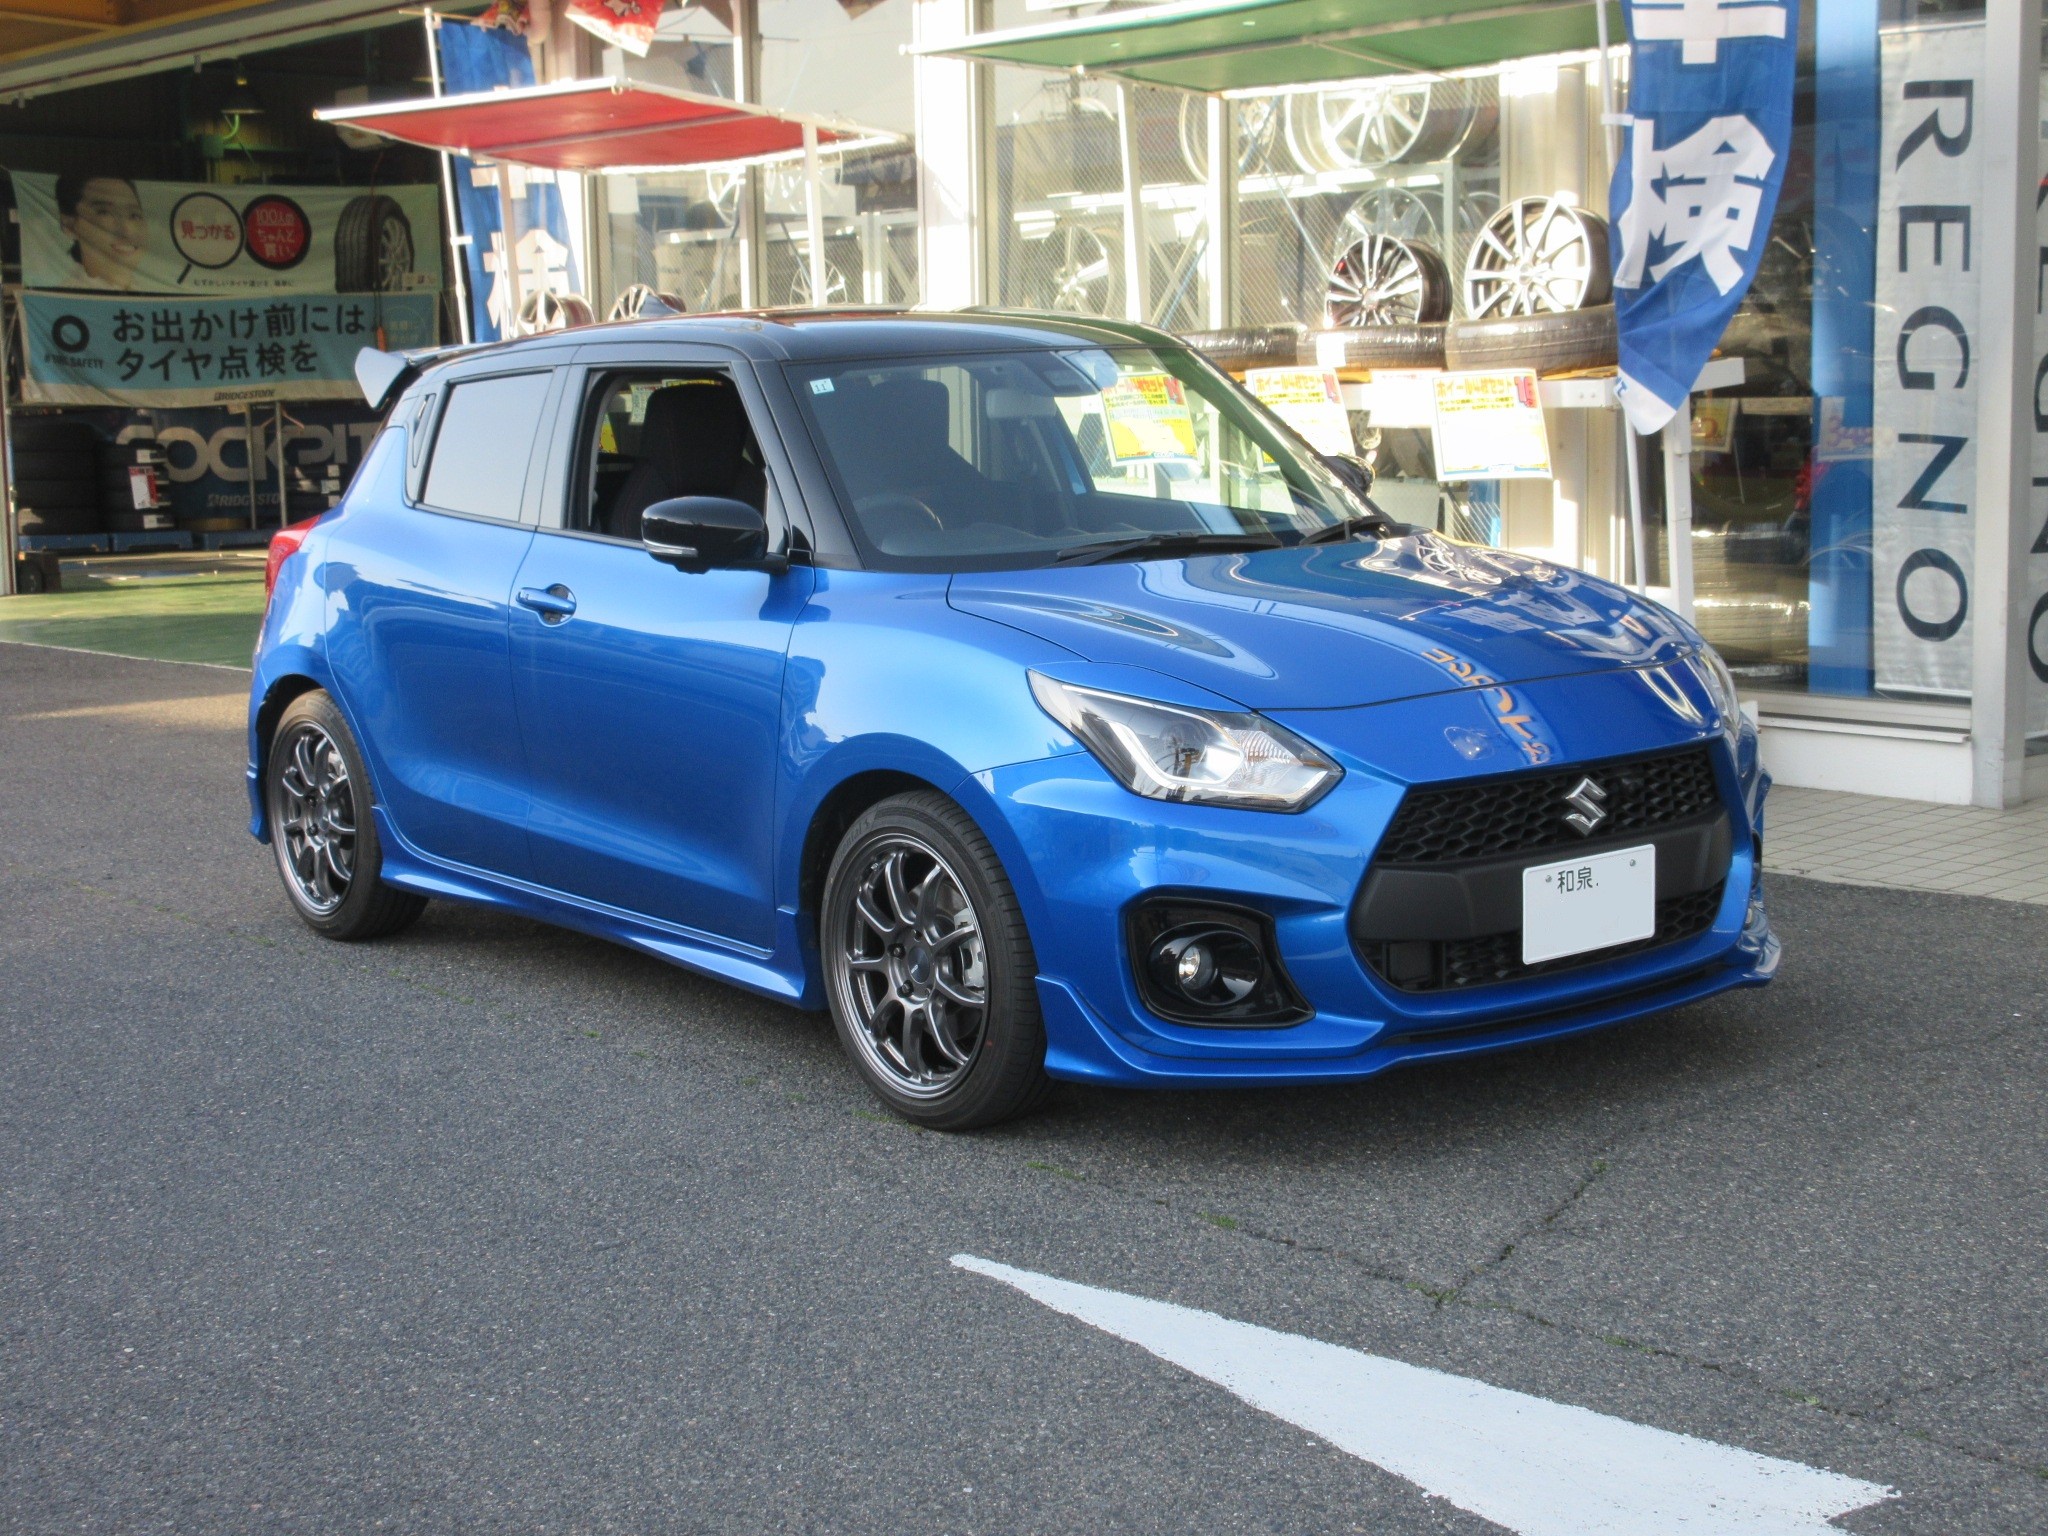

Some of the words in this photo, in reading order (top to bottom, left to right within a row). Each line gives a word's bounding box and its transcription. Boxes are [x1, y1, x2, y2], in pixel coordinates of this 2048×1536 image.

[180, 218, 236, 241] 見つかる
[115, 339, 318, 382] タイヤ点検を
[1894, 78, 1974, 643] REGNO
[213, 388, 276, 402] BRIDGESTONE
[1557, 866, 1593, 894] 和泉
